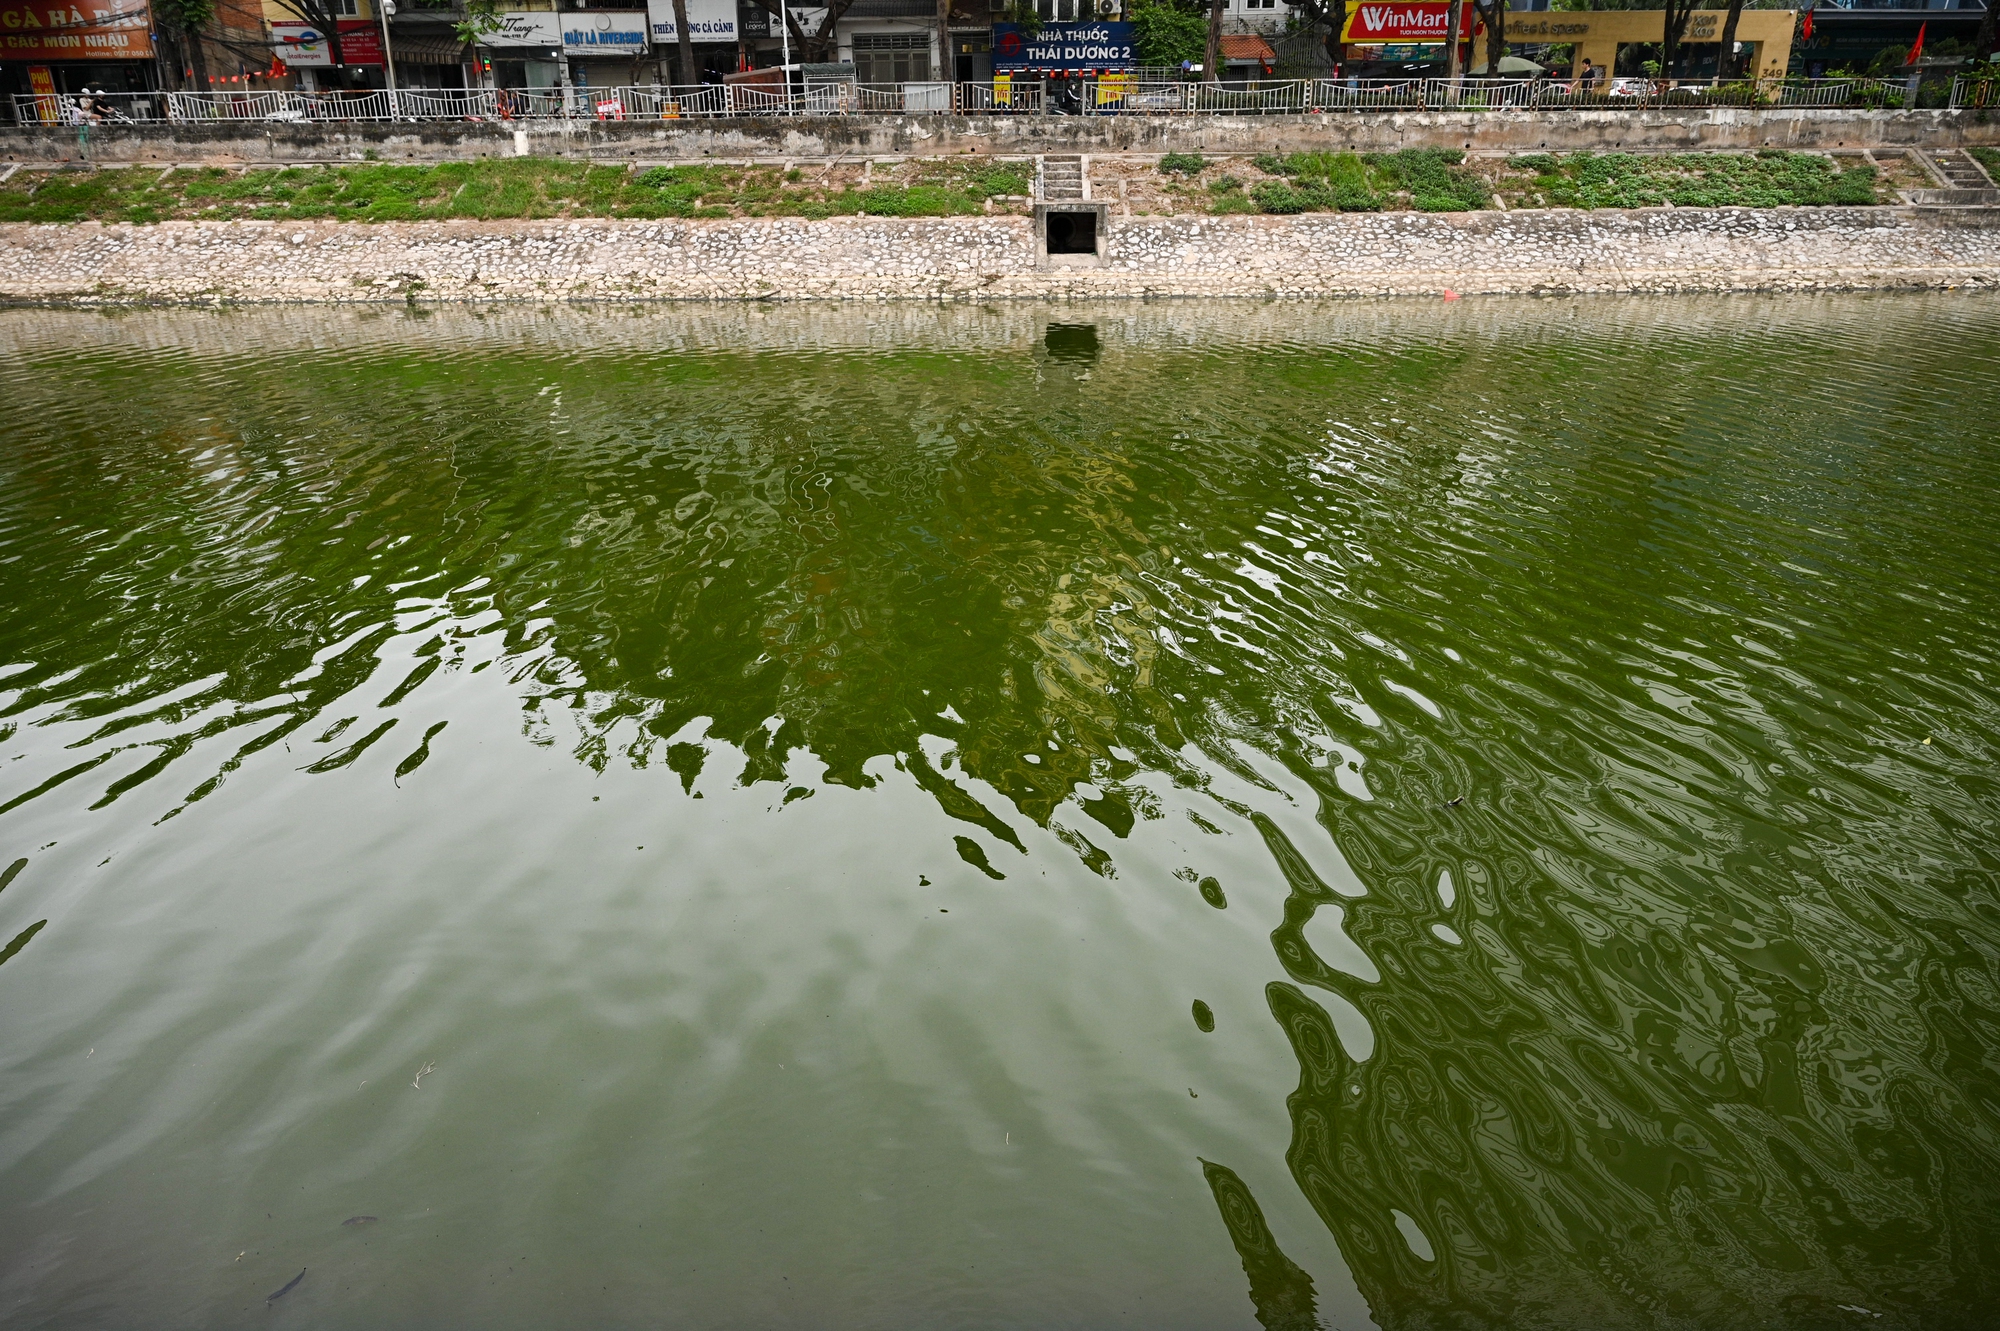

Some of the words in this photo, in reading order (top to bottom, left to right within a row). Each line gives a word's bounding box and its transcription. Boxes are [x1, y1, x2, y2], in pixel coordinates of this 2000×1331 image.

[2, 5, 42, 28] GÀ
[47, 4, 88, 28] HÀ
[1361, 6, 1450, 31] WinMart
[653, 21, 674, 34] THIÊN
[702, 20, 712, 33] CÁ
[745, 23, 767, 31] Legend
[1036, 29, 1063, 41] NHÀ
[1066, 26, 1109, 41] THUỐC
[1504, 20, 1538, 35] offee
[84, 33, 129, 50] NHẬU
[564, 29, 583, 46] GIẶT
[585, 29, 597, 44] LÀ
[599, 32, 644, 44] RIVERSIDE
[1026, 44, 1061, 60] THÁI
[1064, 44, 1119, 60] DƯƠNG
[1121, 46, 1131, 59] 2
[31, 69, 50, 85] PHỞ
[1761, 68, 1783, 78] 349
